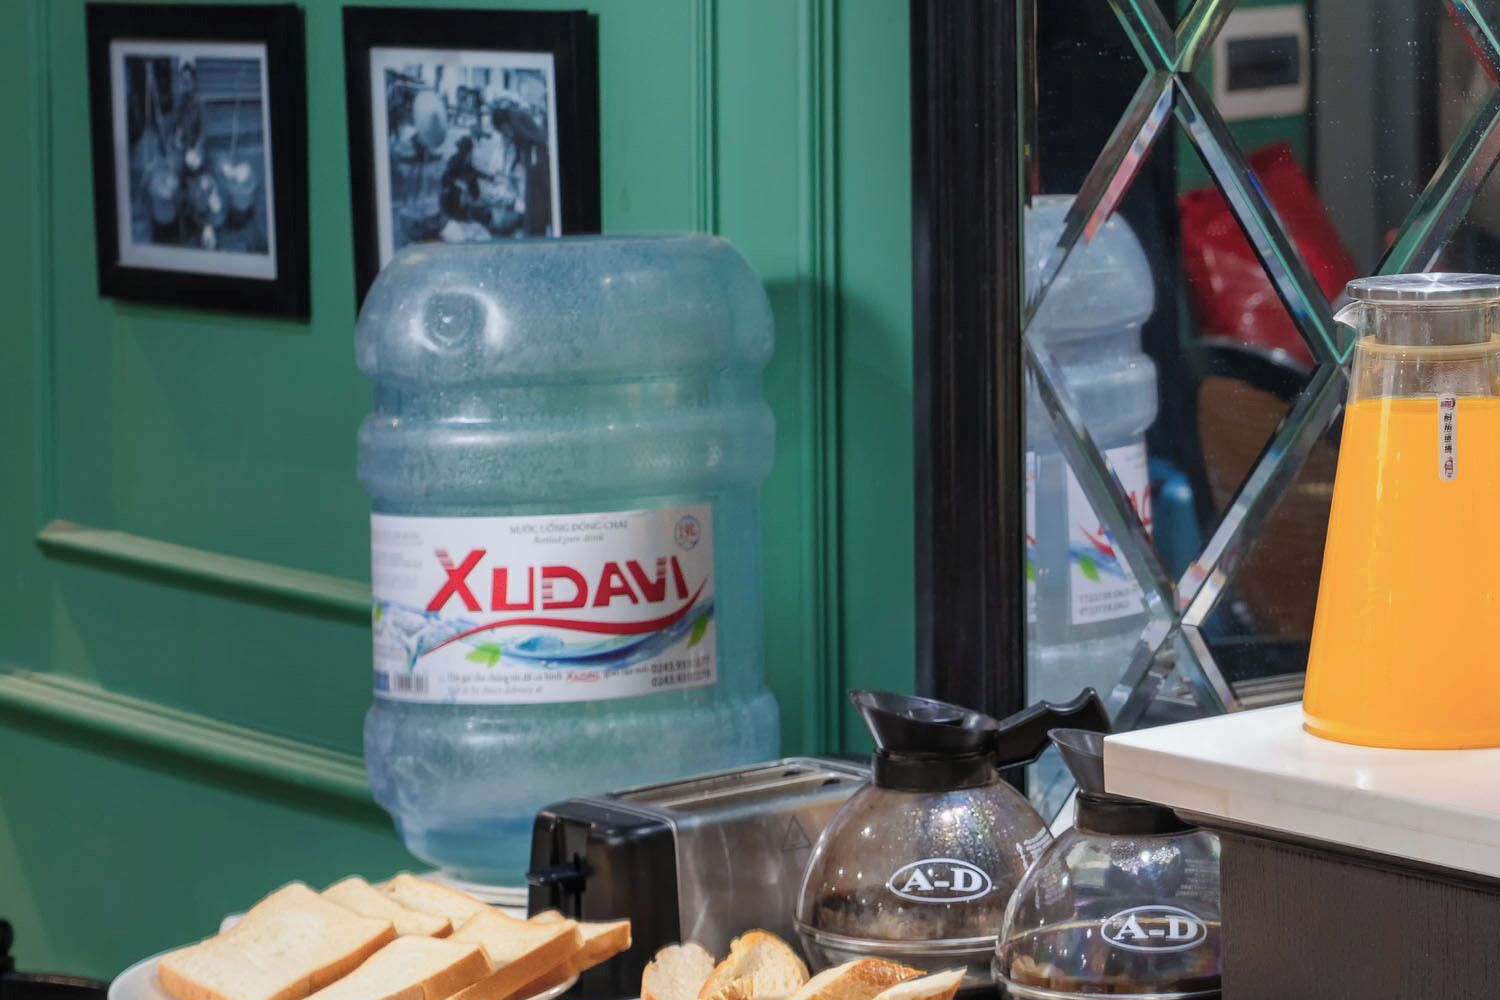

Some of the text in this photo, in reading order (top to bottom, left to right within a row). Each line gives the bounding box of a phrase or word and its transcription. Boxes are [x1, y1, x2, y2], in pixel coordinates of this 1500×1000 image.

[426, 548, 690, 612] XUDAVI
[900, 866, 984, 893] A-D
[1112, 916, 1199, 942] A-D
